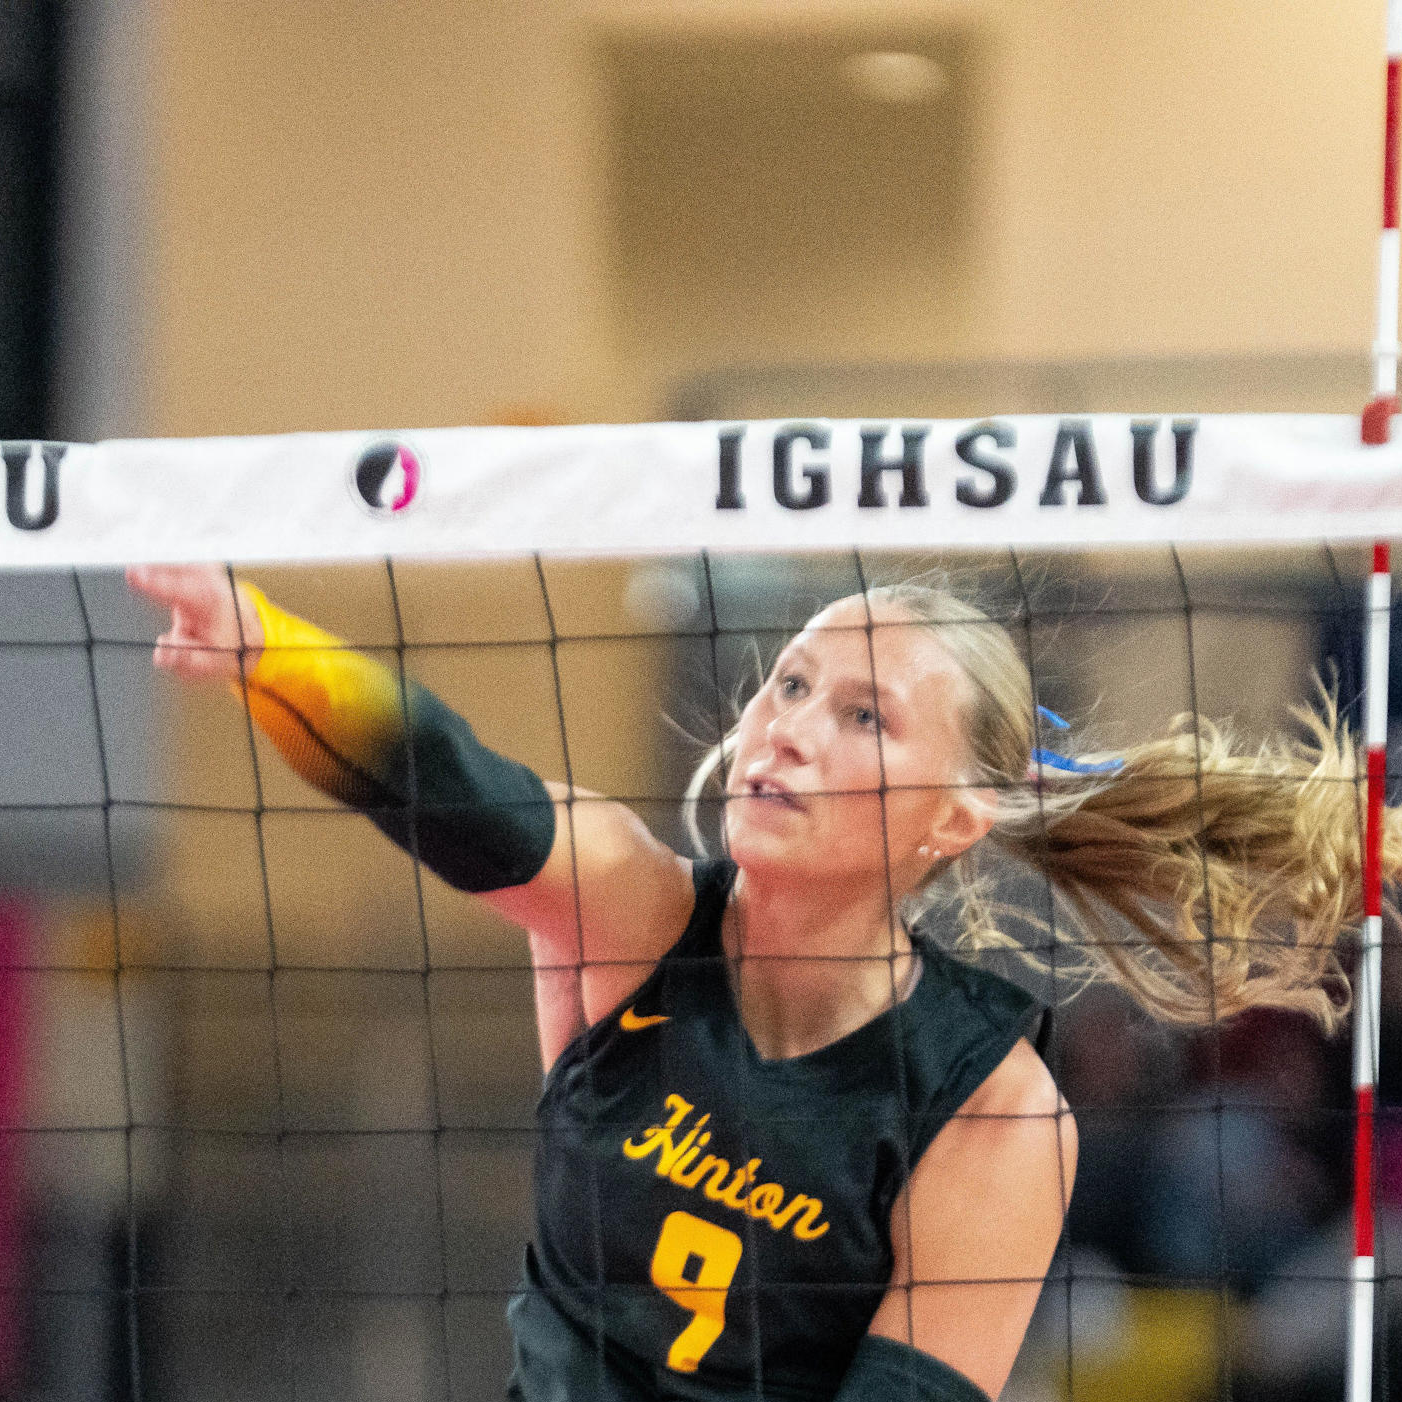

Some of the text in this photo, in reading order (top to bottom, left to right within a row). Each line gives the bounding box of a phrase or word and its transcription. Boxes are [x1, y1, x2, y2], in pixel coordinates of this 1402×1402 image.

[715, 418, 1200, 511] IGHSAU
[622, 1093, 830, 1241] Hinton
[650, 1210, 744, 1373] 9
